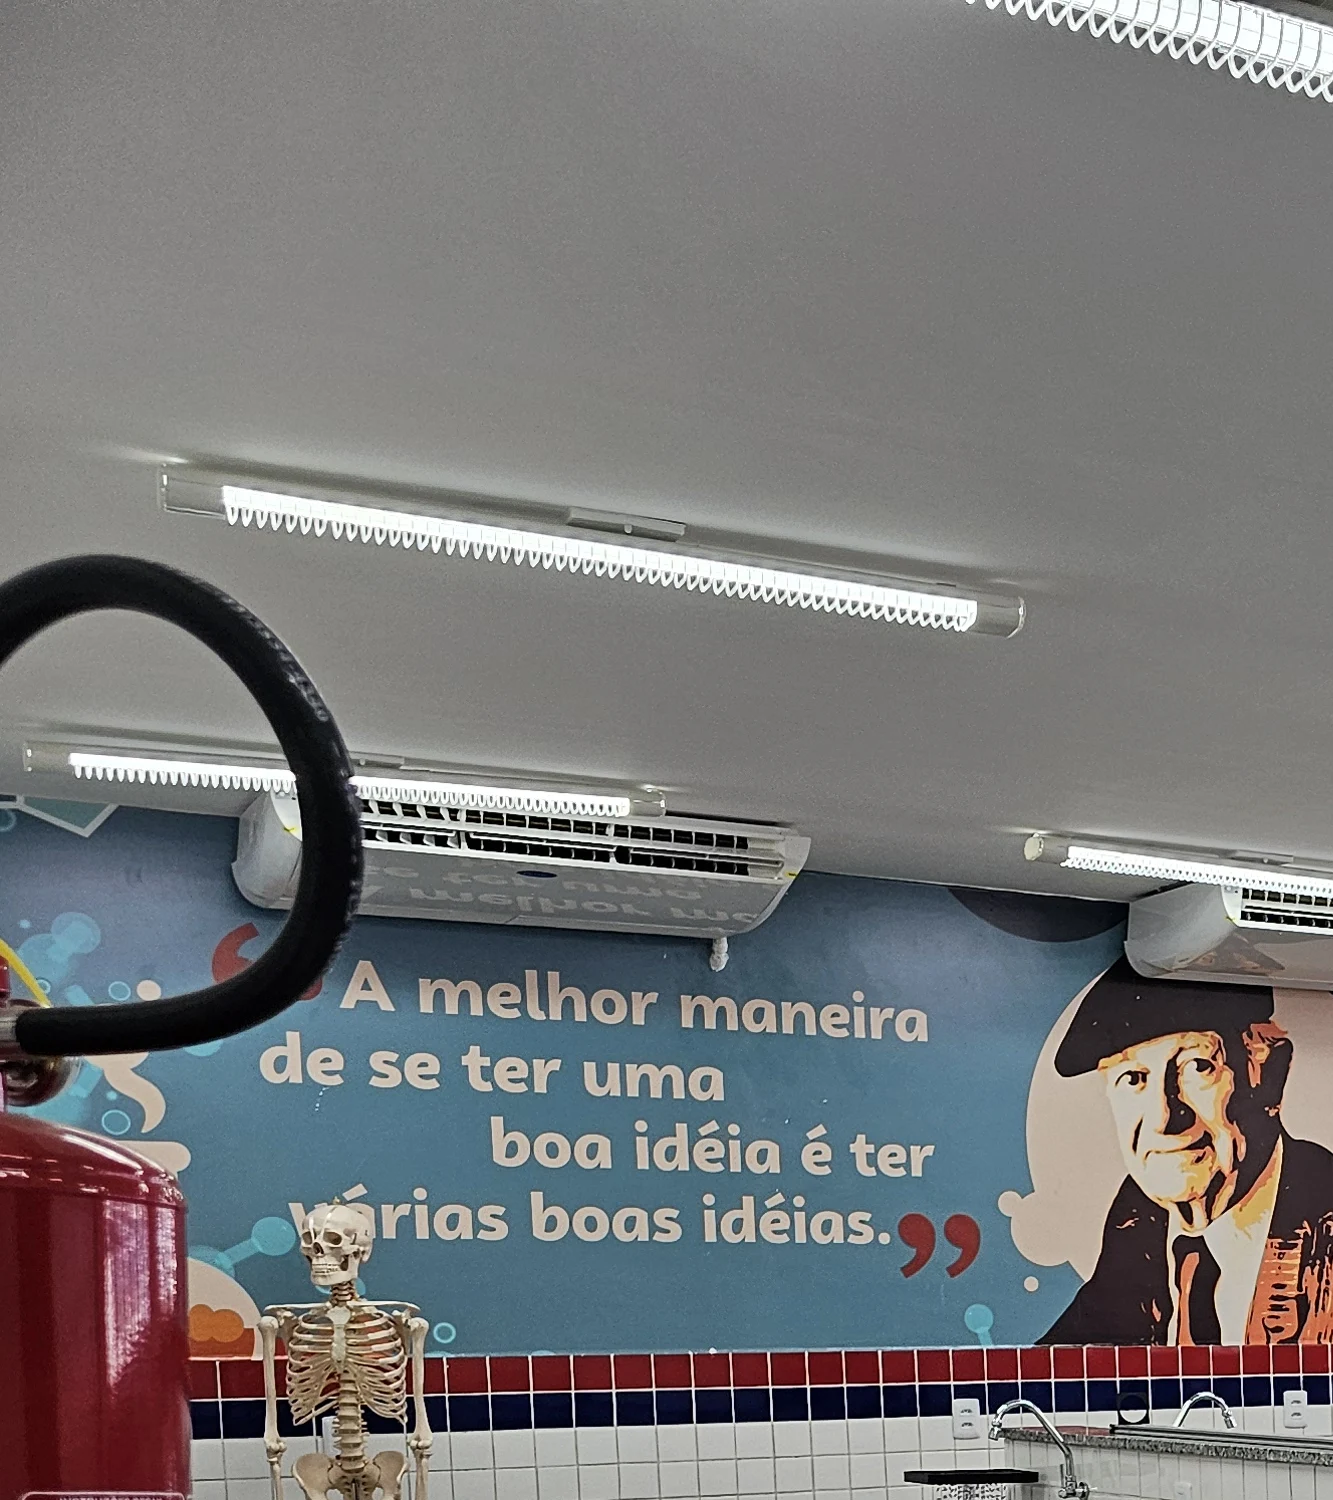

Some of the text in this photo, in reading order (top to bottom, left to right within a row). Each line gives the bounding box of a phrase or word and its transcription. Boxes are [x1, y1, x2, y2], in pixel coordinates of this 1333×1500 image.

[339, 960, 930, 1043] A melhor maneira
[259, 1031, 725, 1102] de se ter uma
[490, 1115, 935, 1178] boa idéia é ter
[530, 1190, 682, 1244] boas
[703, 1190, 892, 1245] idéias.
